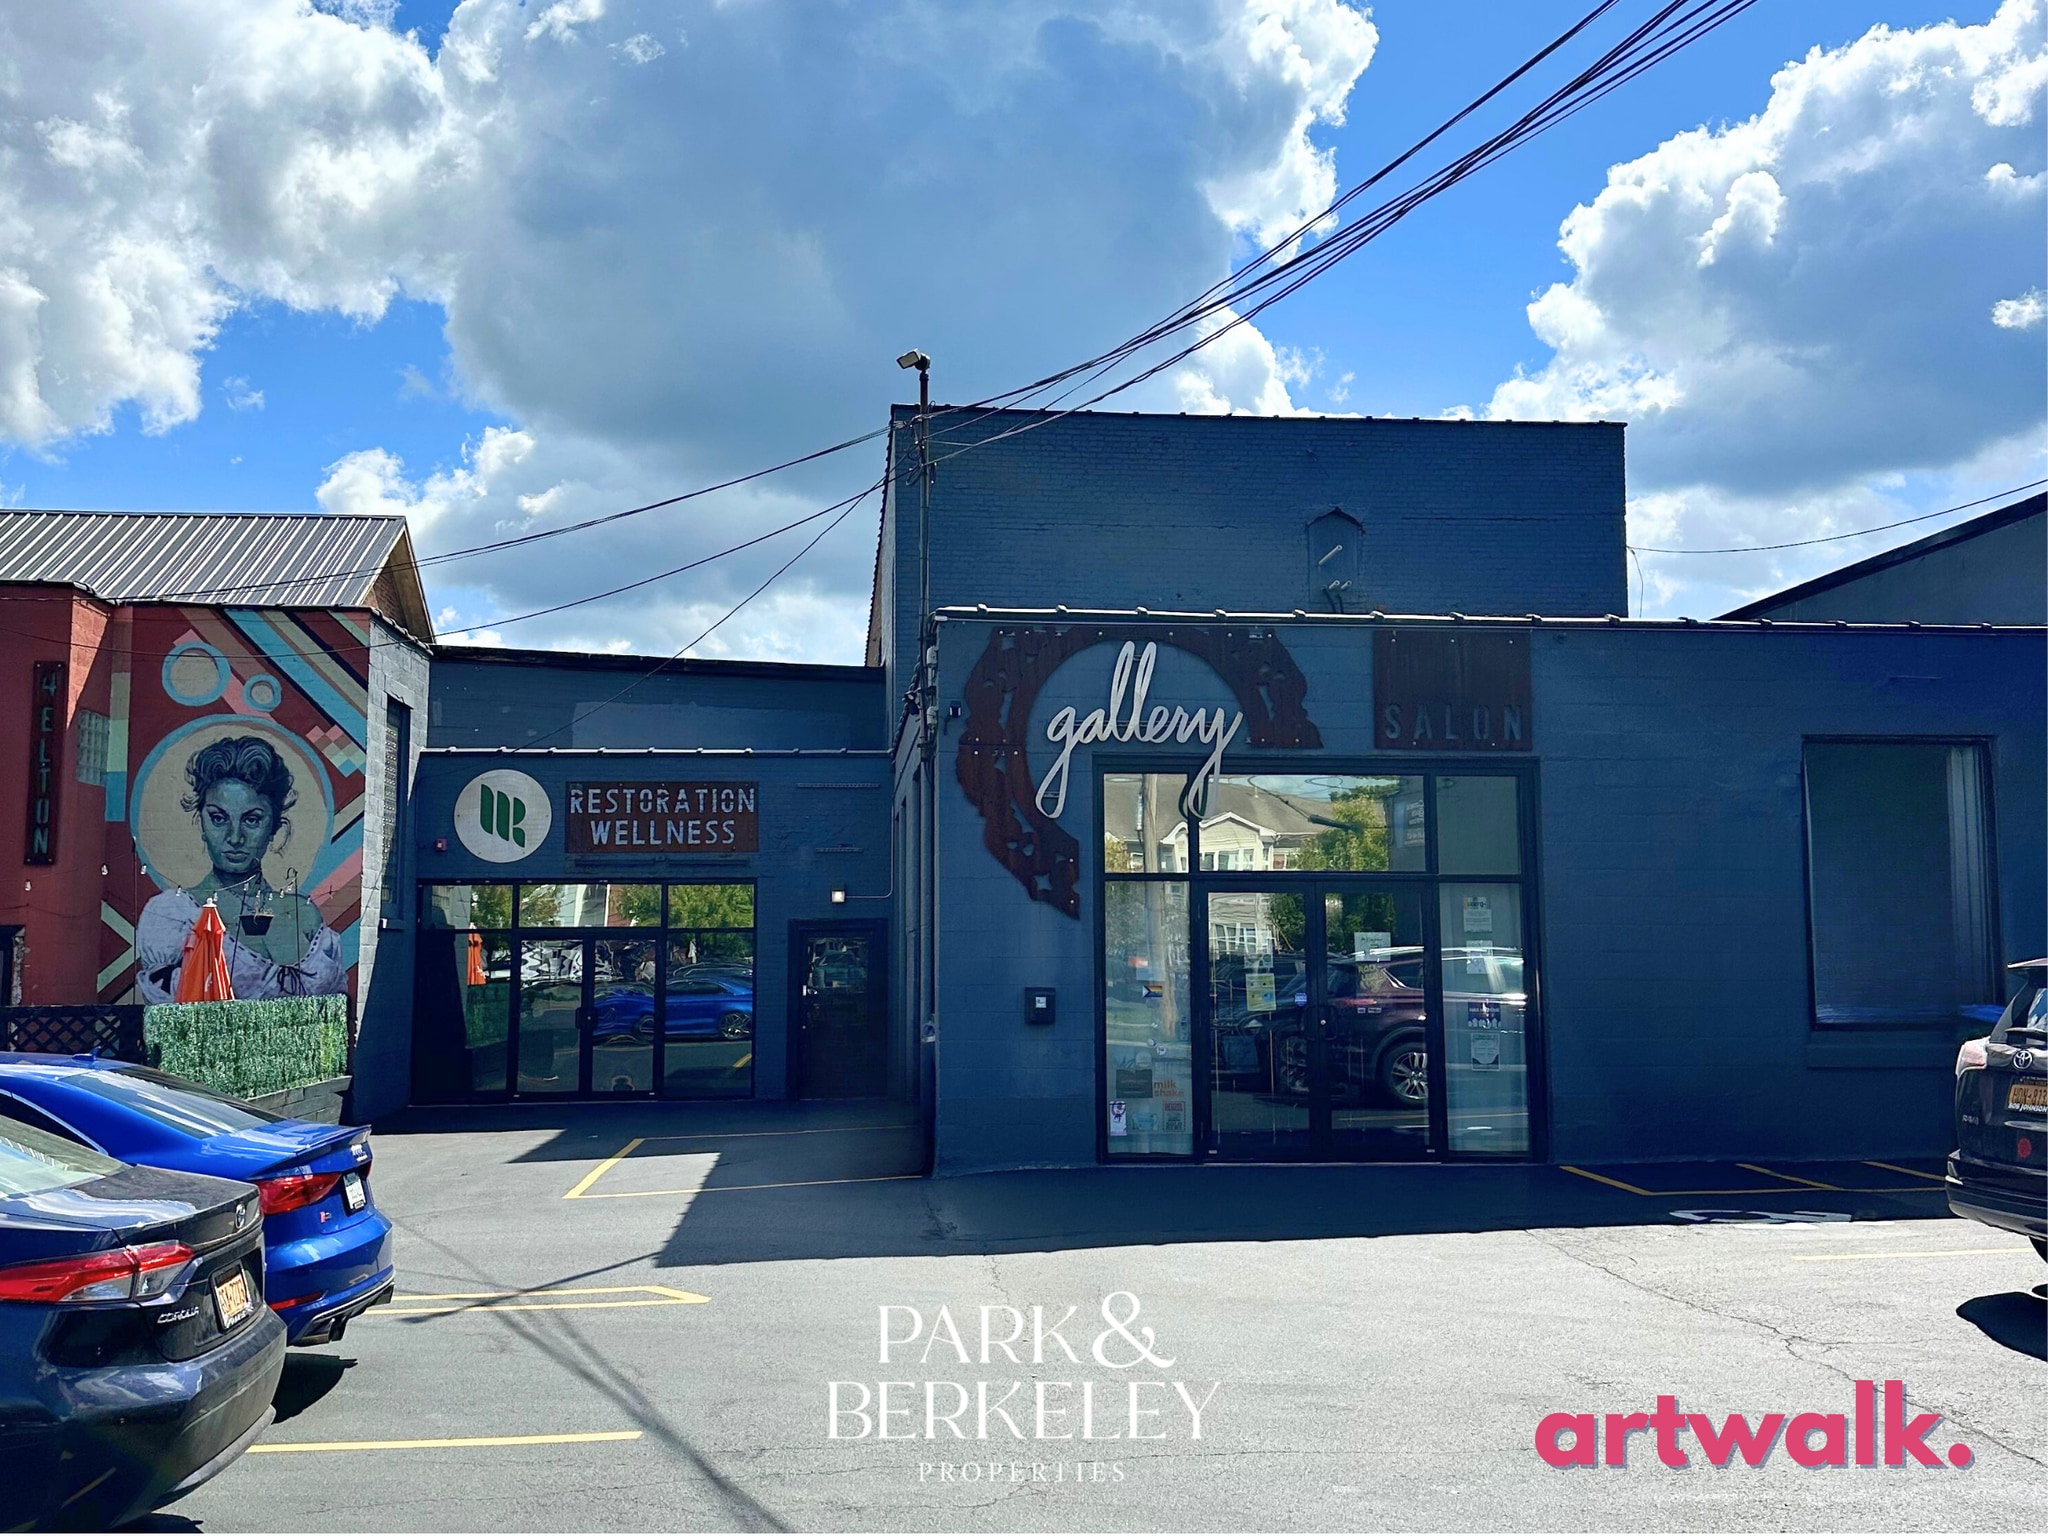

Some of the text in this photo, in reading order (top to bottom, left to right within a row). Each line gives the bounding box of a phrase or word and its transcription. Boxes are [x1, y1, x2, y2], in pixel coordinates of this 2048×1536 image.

[42, 672, 57, 696] 4
[1035, 640, 1244, 820] gallery
[1385, 704, 1523, 740] SALON
[570, 788, 755, 814] RESTORATION
[590, 819, 735, 846] WELLNESS
